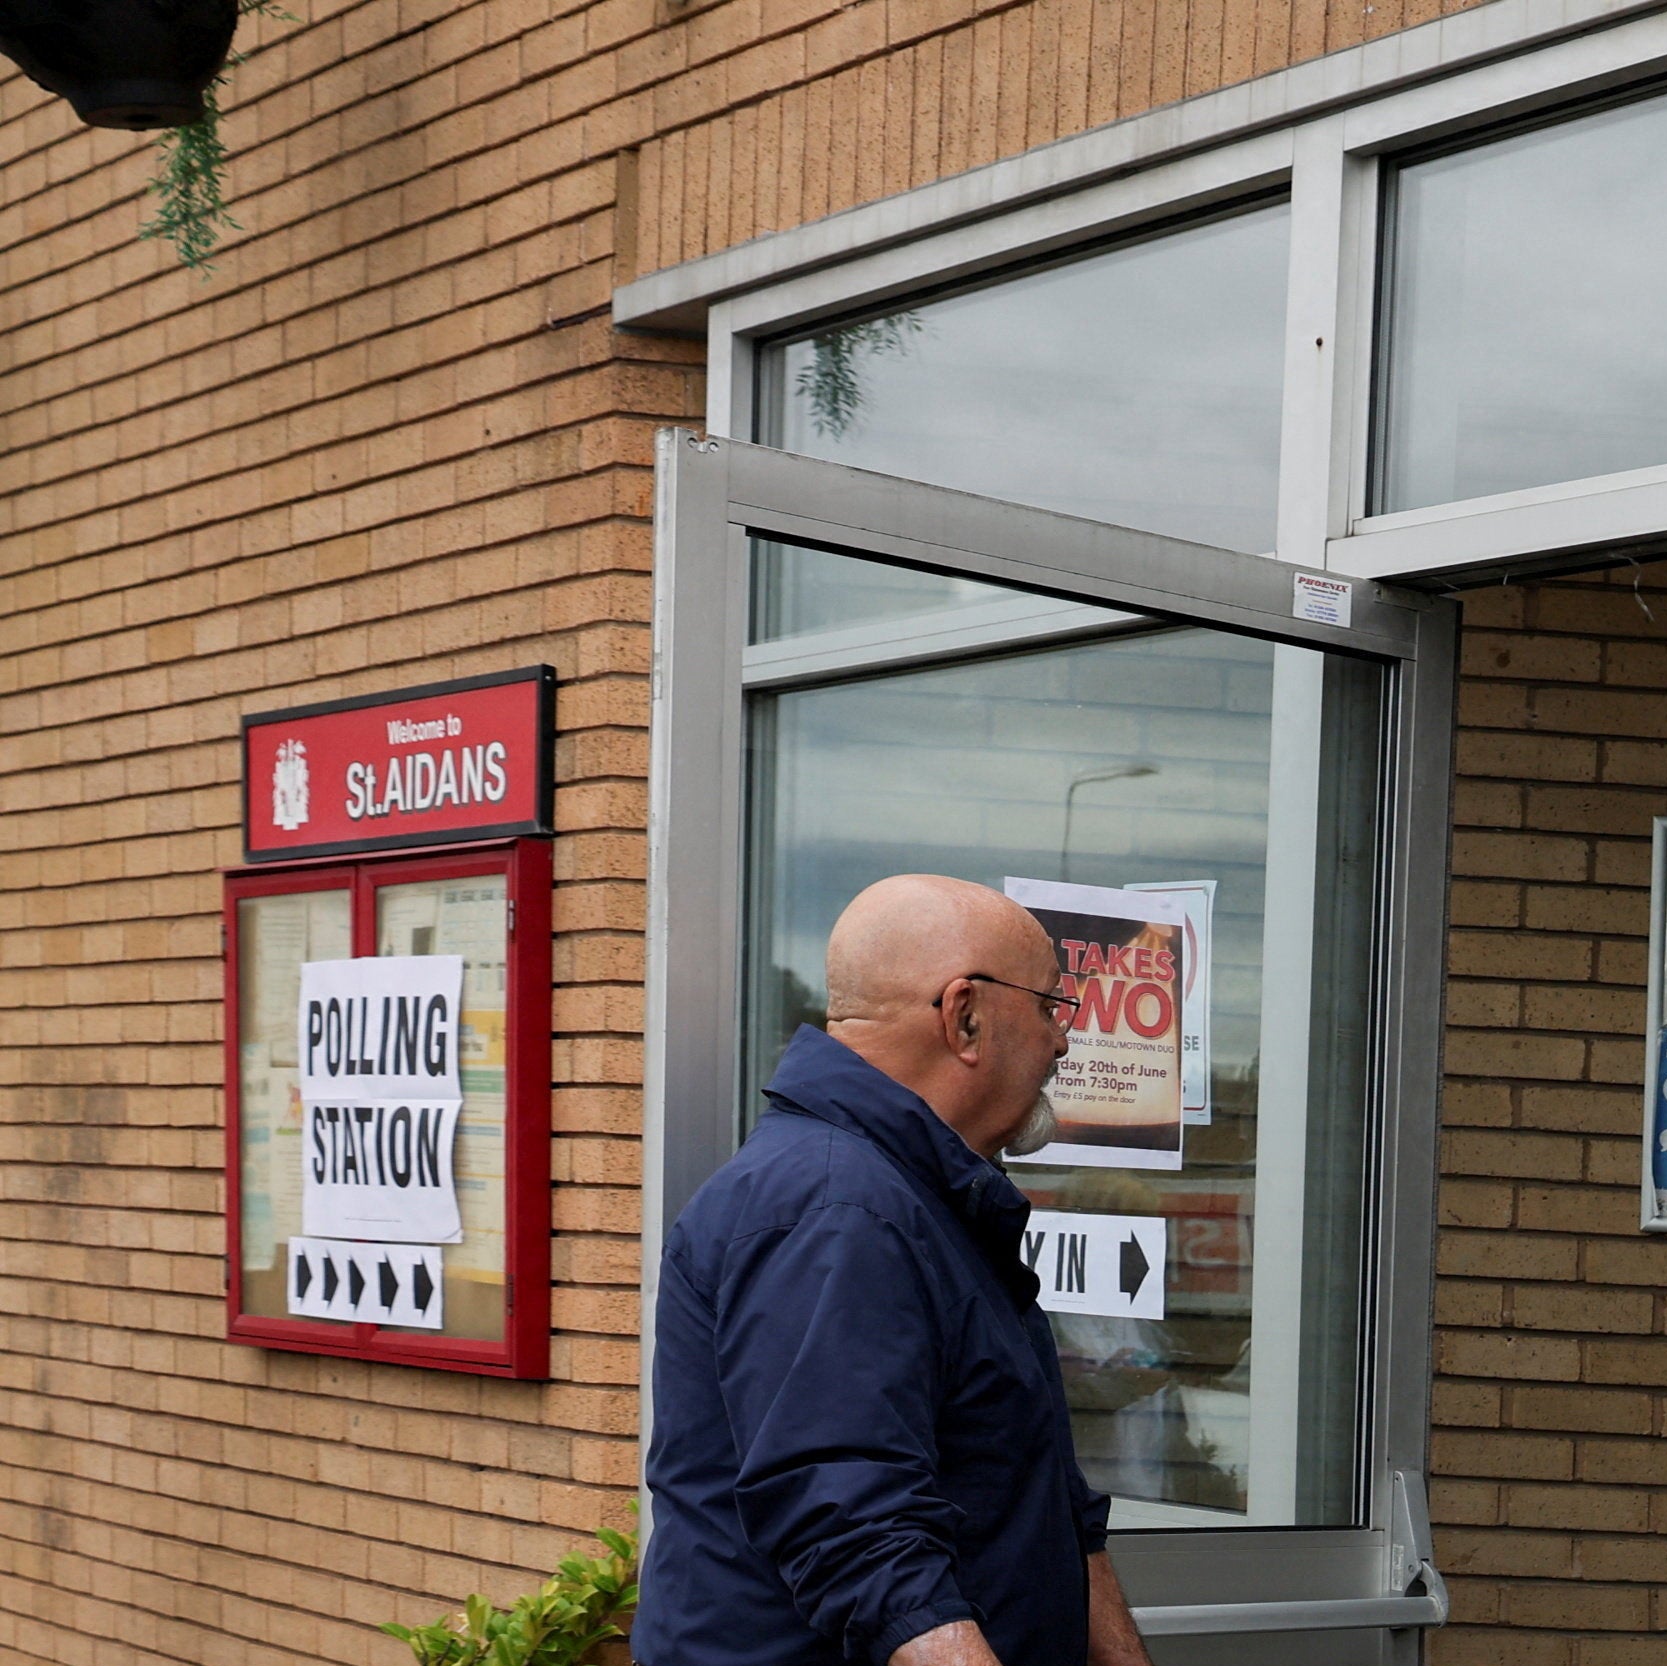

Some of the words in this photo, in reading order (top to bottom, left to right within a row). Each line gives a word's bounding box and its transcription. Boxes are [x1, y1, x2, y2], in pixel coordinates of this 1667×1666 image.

[387, 718, 445, 745] Welcome
[447, 713, 462, 737] to
[346, 741, 506, 821] St.AIDANS
[1061, 939, 1175, 982] TAKES
[1055, 974, 1173, 1040] WO
[308, 994, 447, 1077] POLLING
[1067, 1036, 1093, 1047] EMALE
[1095, 1038, 1156, 1052] SOUL/MOTOWN
[1157, 1045, 1174, 1053] DUO
[1055, 1073, 1086, 1087] from
[1090, 1076, 1137, 1093] 7:30pm
[1057, 1059, 1084, 1074] rday
[1089, 1060, 1117, 1074] 20th
[1121, 1062, 1135, 1075] of
[1137, 1064, 1166, 1078] June
[313, 1105, 444, 1188] STATION
[1055, 1232, 1087, 1293] IN
